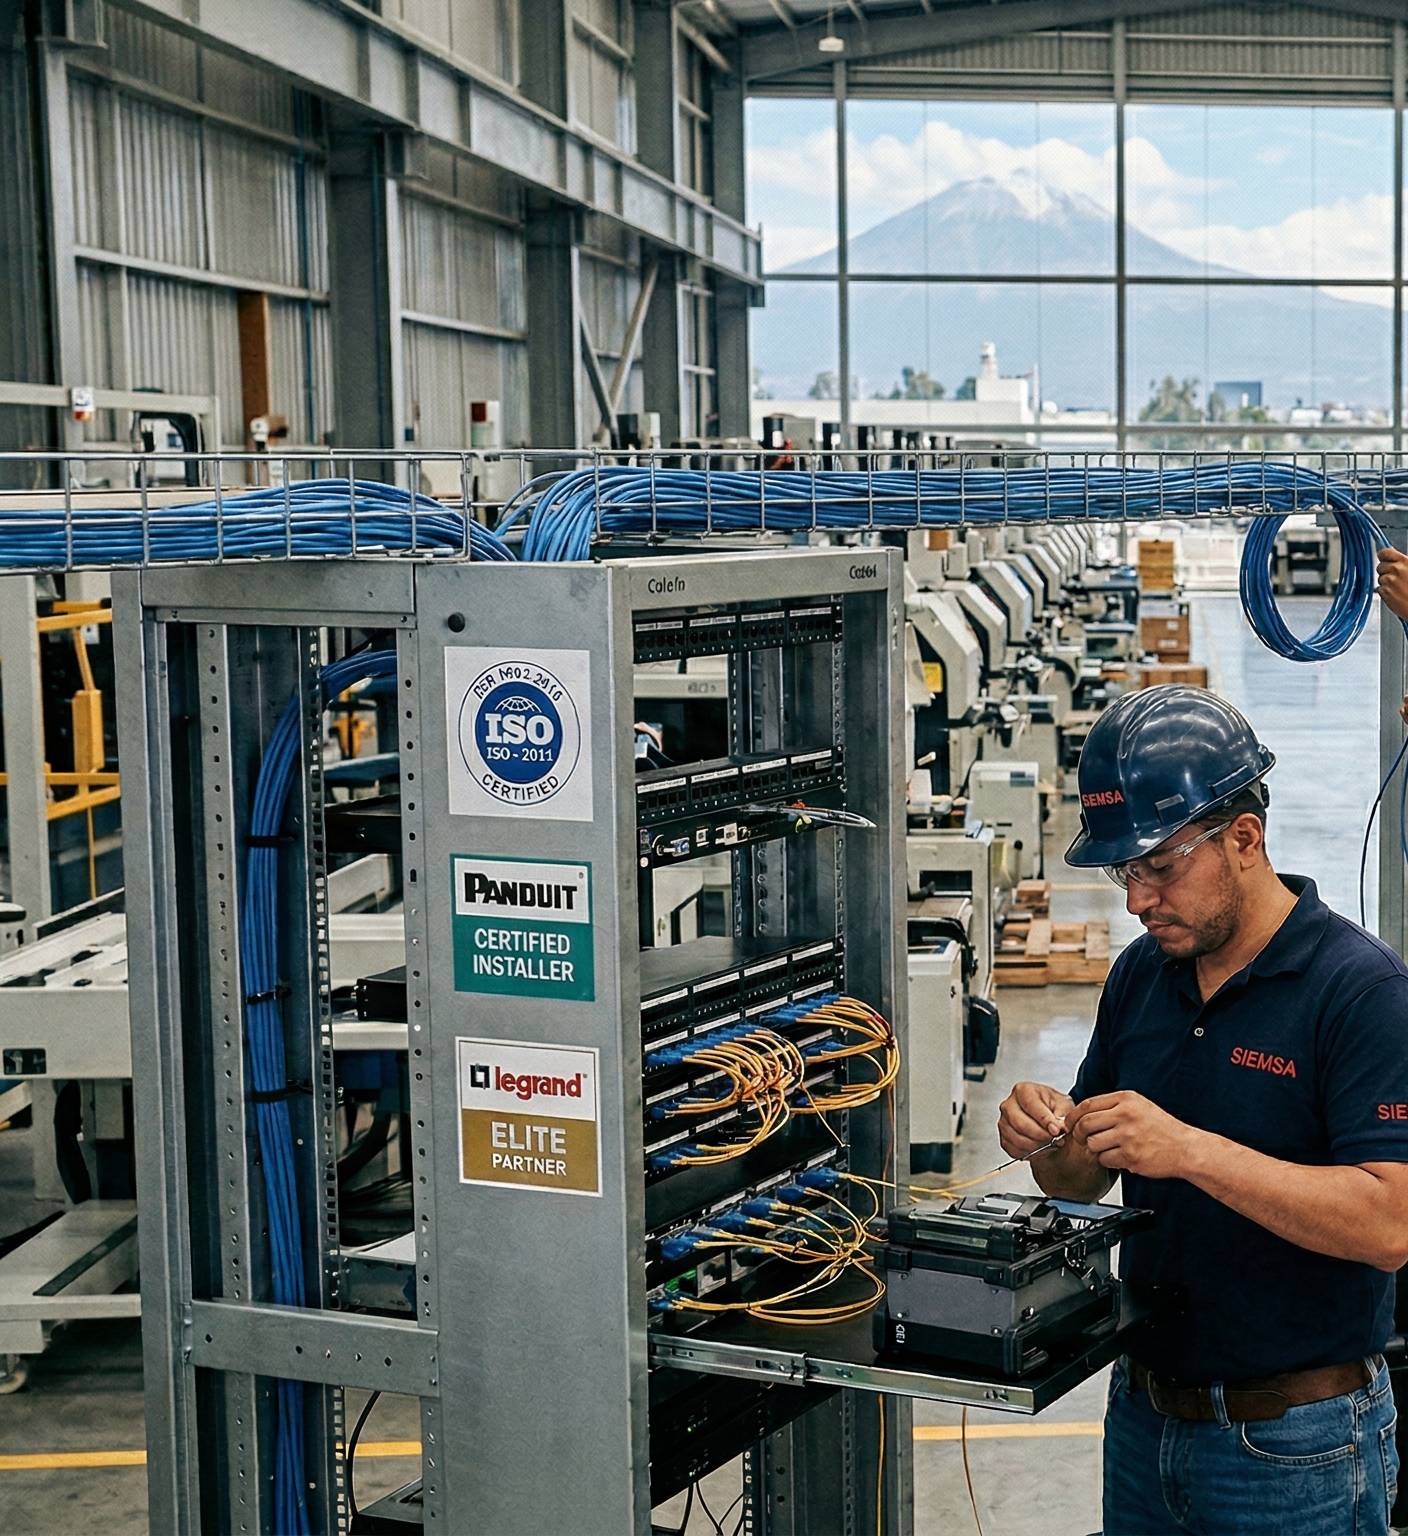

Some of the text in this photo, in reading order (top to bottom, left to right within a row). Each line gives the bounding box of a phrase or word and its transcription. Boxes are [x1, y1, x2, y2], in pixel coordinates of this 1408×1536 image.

[485, 713, 554, 745] ISO
[487, 747, 510, 760] ISO
[521, 748, 554, 762] 2011
[482, 773, 559, 801] CERTIFIED
[464, 872, 577, 910] PANDUIT
[474, 928, 570, 955] CERTIFIED
[473, 954, 574, 982] INSTALLER
[1230, 1047, 1296, 1078] SIEMSA
[495, 1066, 581, 1101] legrand
[492, 1121, 567, 1155] ELITE
[492, 1153, 567, 1176] PARTNER
